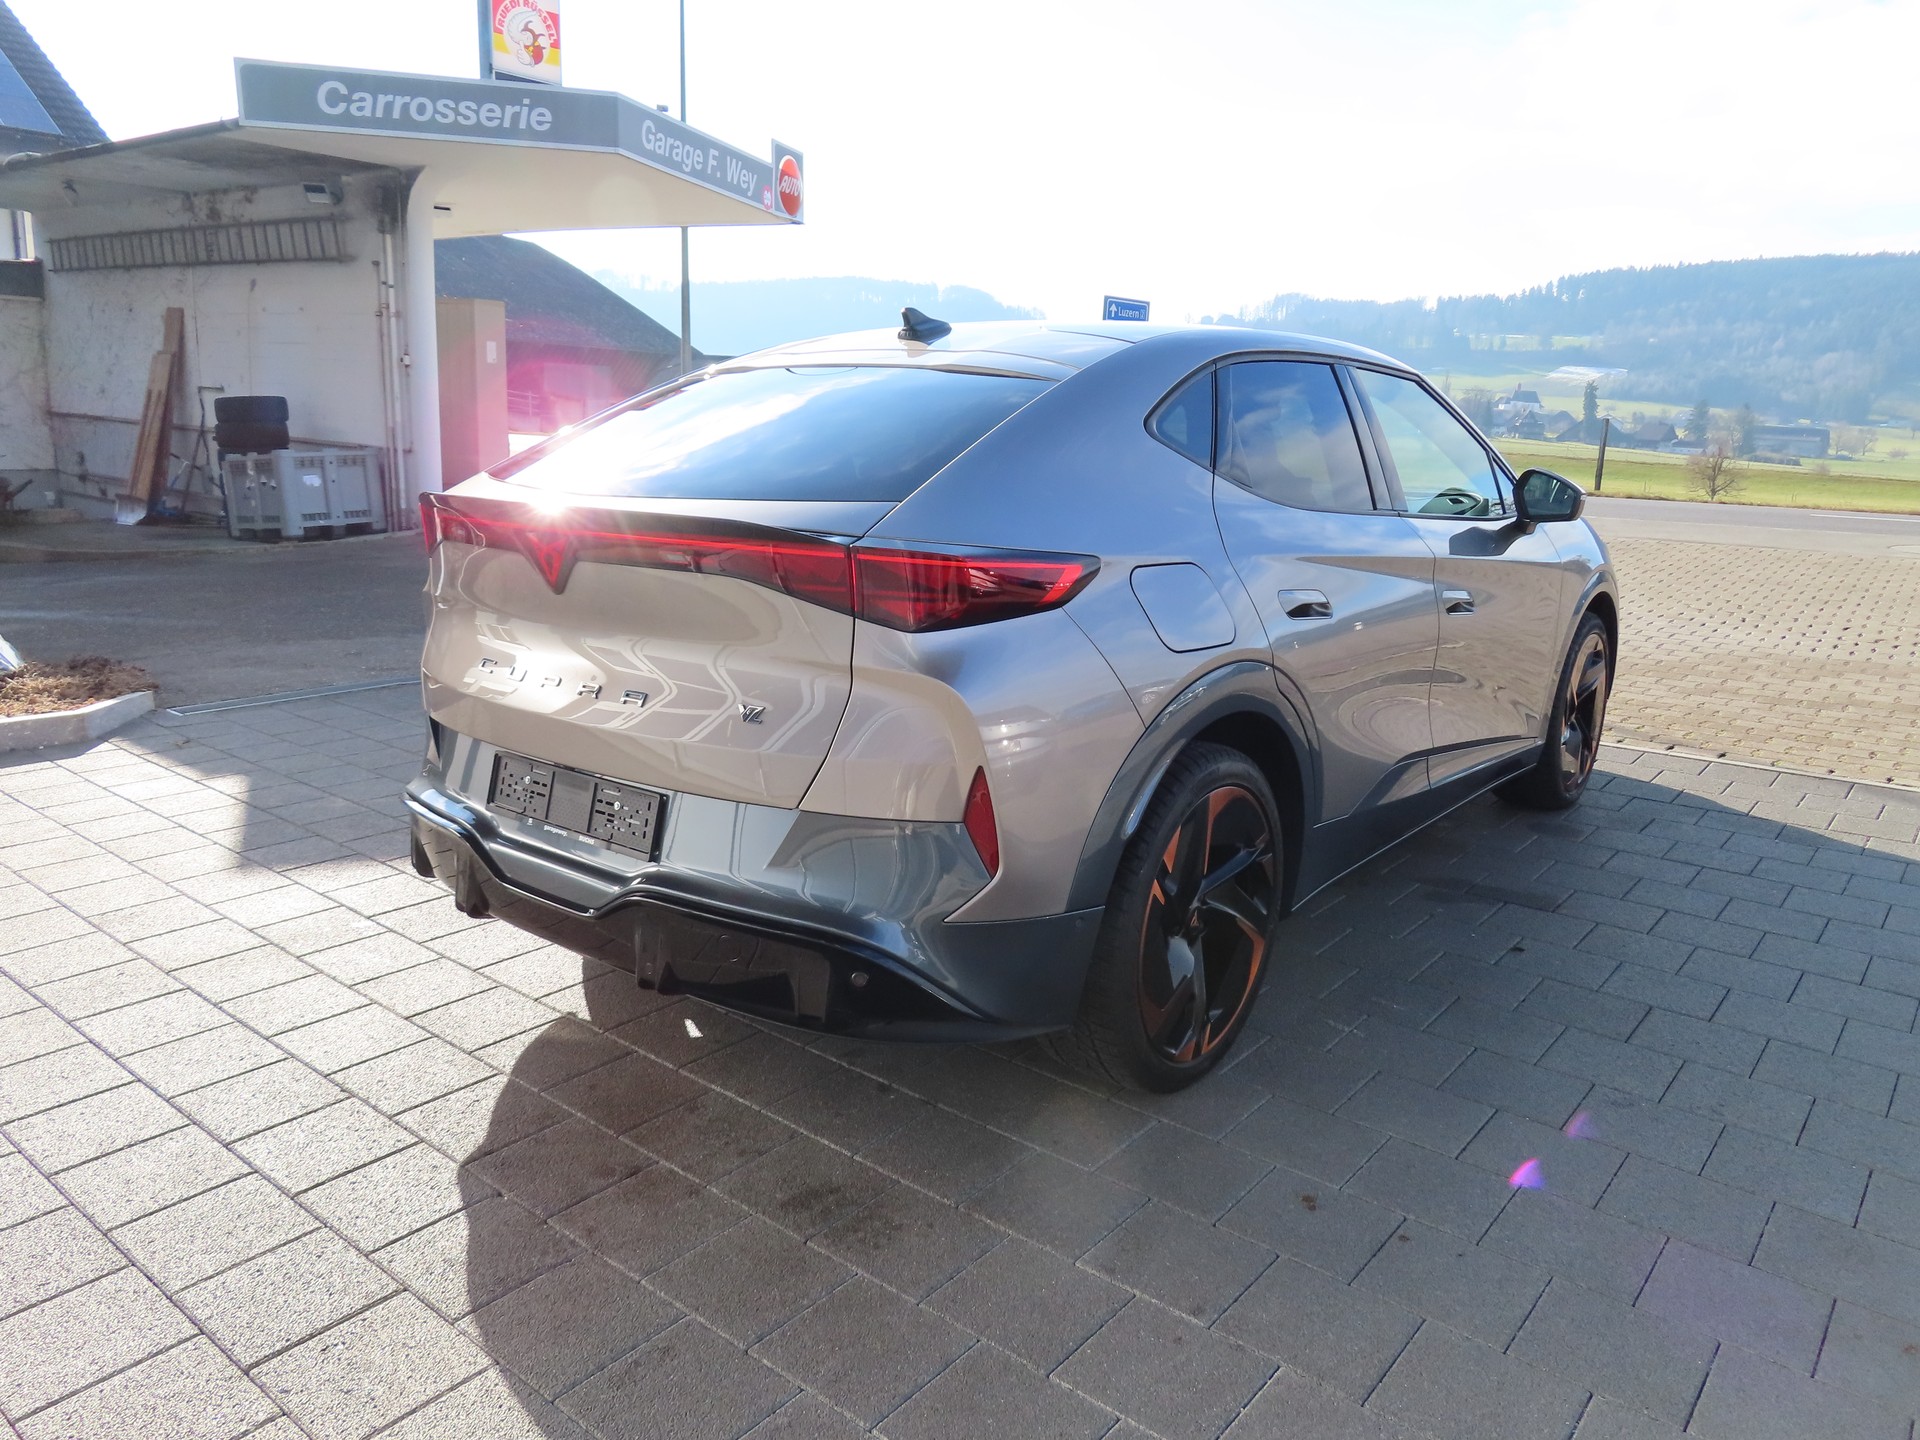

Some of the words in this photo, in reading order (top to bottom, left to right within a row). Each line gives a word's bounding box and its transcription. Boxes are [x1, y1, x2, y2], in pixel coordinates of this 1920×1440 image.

[497, 0, 521, 28] RUEDI
[523, 0, 556, 41] RÜSSEL
[317, 80, 553, 131] Carrosserie
[641, 119, 704, 172] Garage
[707, 147, 721, 178] F.
[726, 155, 758, 196] Wey
[1118, 306, 1140, 319] Luzern
[478, 657, 649, 708] CUPRA
